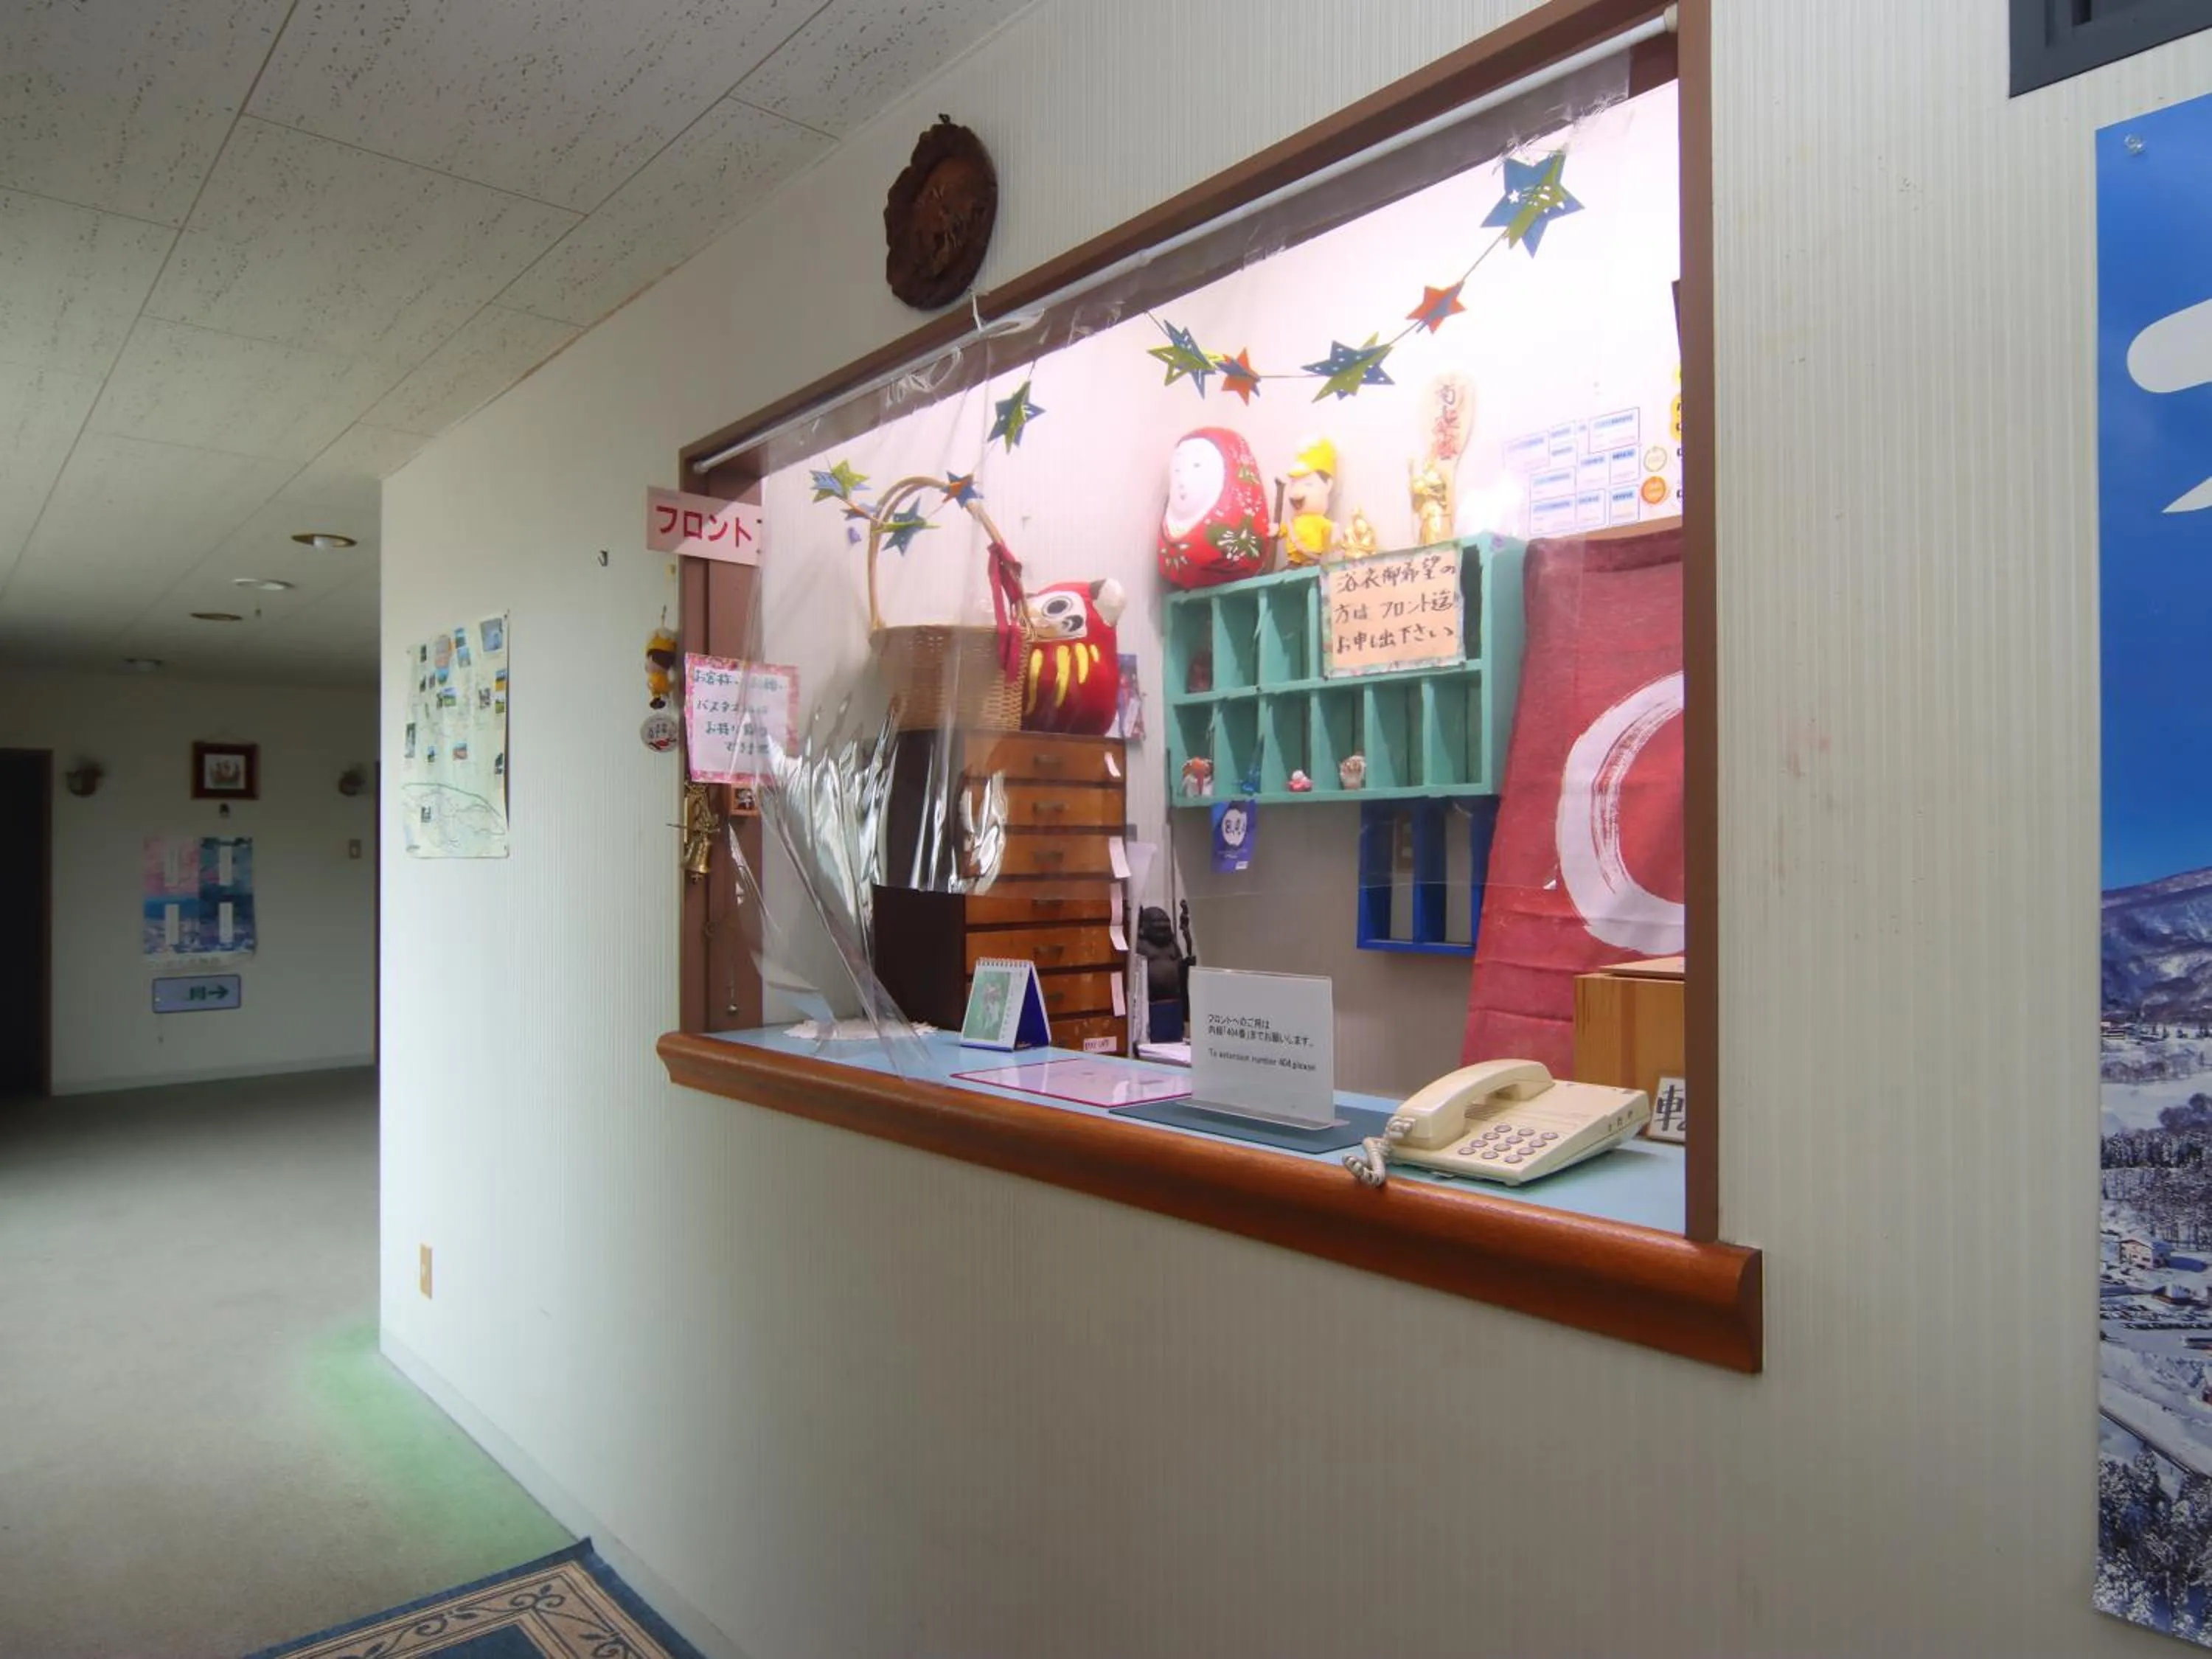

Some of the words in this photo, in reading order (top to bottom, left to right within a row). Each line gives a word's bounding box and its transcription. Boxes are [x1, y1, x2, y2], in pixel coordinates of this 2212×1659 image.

[655, 505, 752, 548] フロント
[1337, 623, 1455, 654] お申し出下さい
[1208, 1014, 1270, 1029] フロントへのご用は
[1208, 1048, 1217, 1057] To
